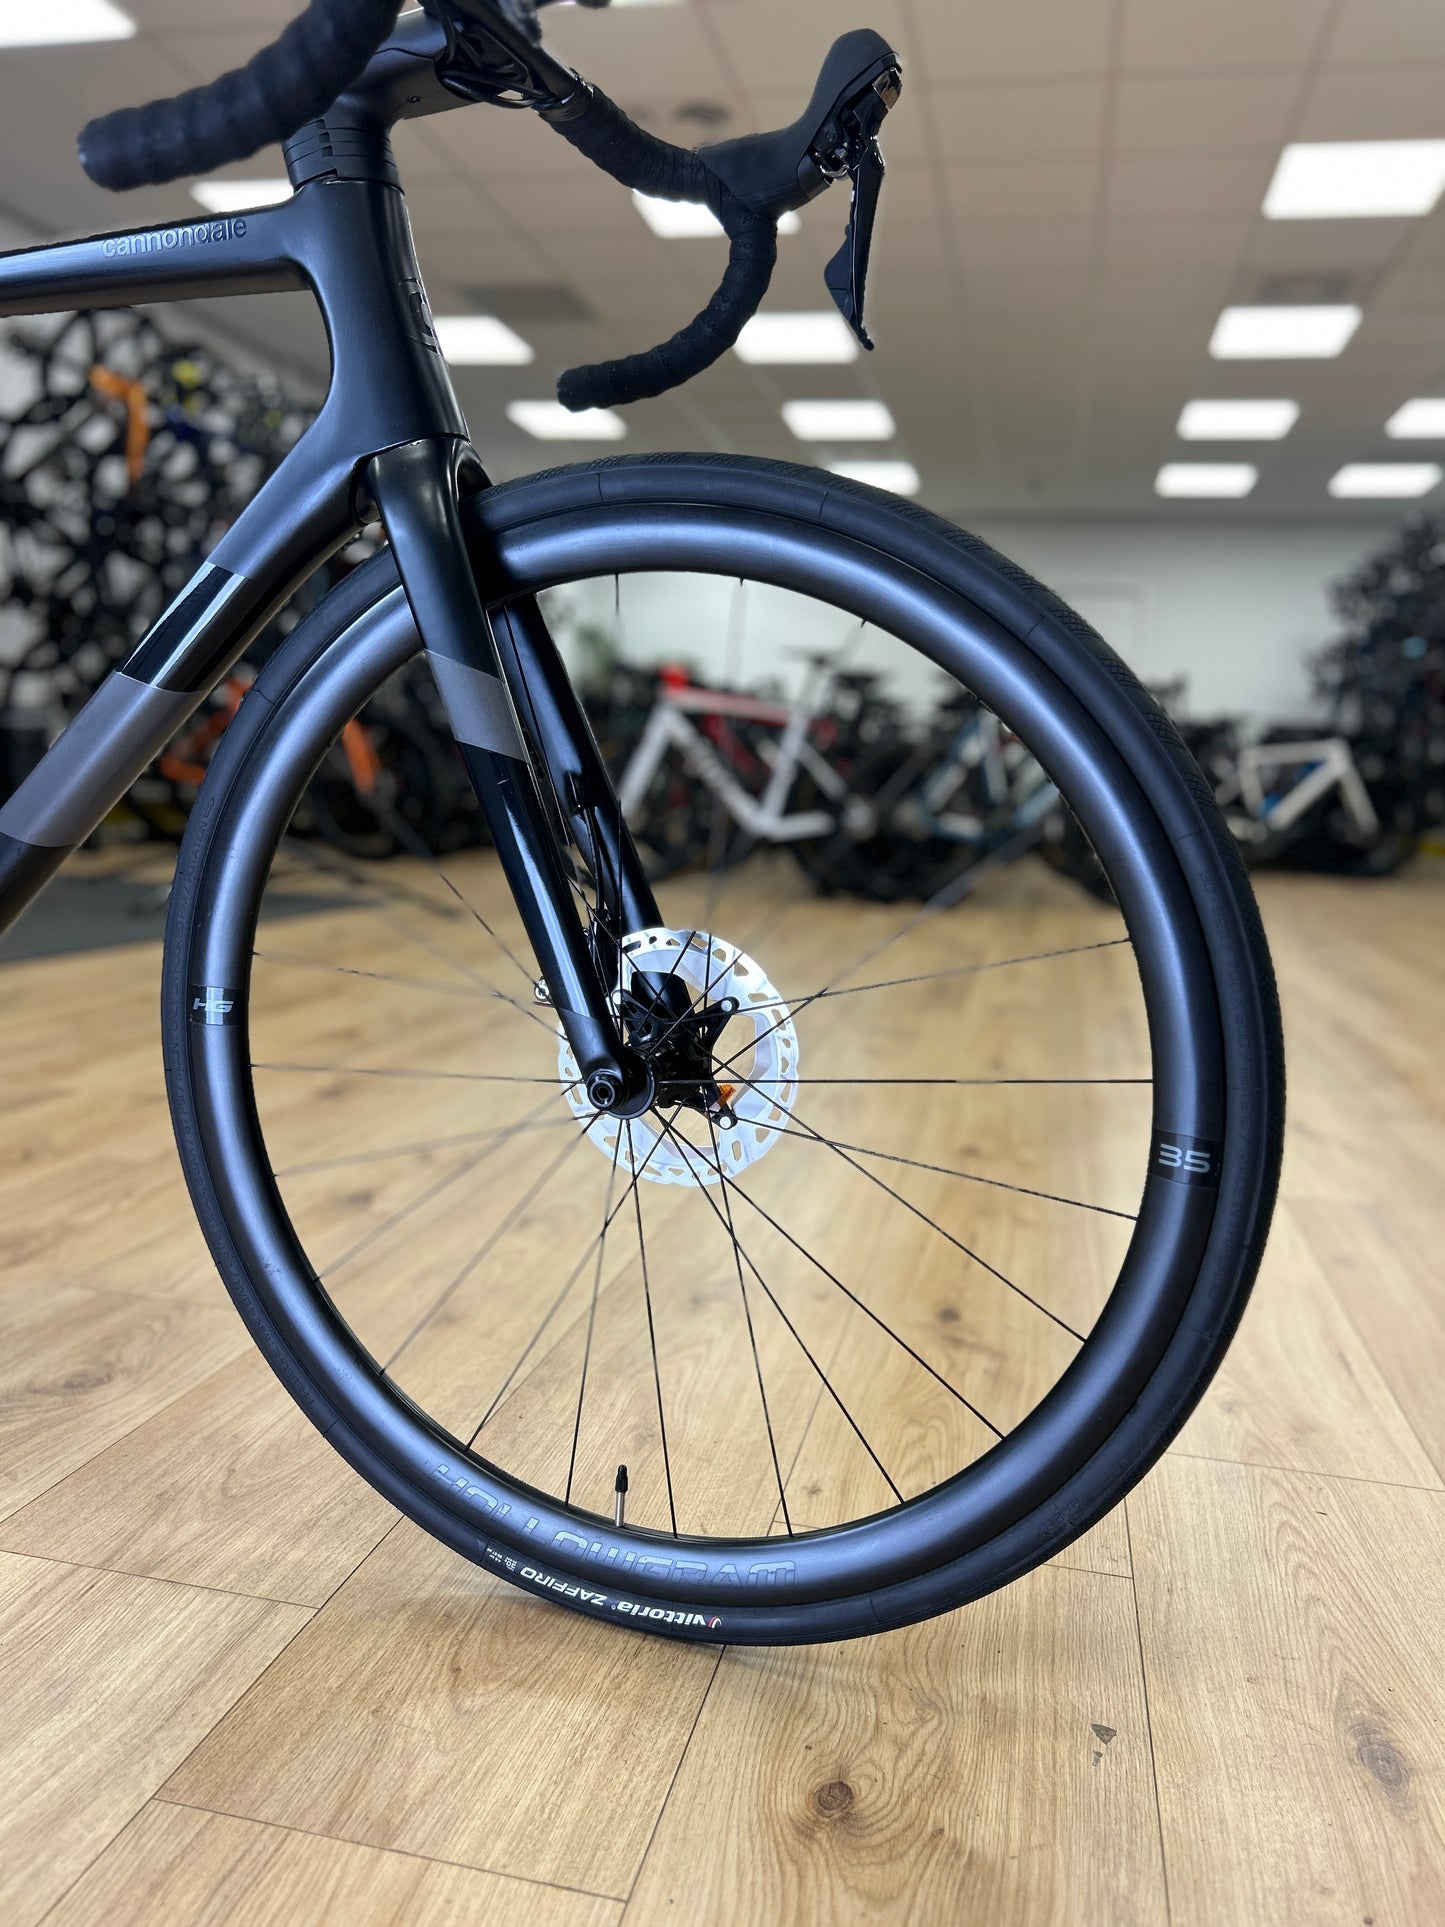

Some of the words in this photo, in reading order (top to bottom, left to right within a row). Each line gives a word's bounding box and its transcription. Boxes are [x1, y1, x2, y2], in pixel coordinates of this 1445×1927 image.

[102, 218, 247, 257] cannondale
[1158, 1143, 1211, 1173] 35
[432, 1463, 796, 1588] HOLLOWGRAM
[520, 1566, 607, 1606] ZAFFIRO
